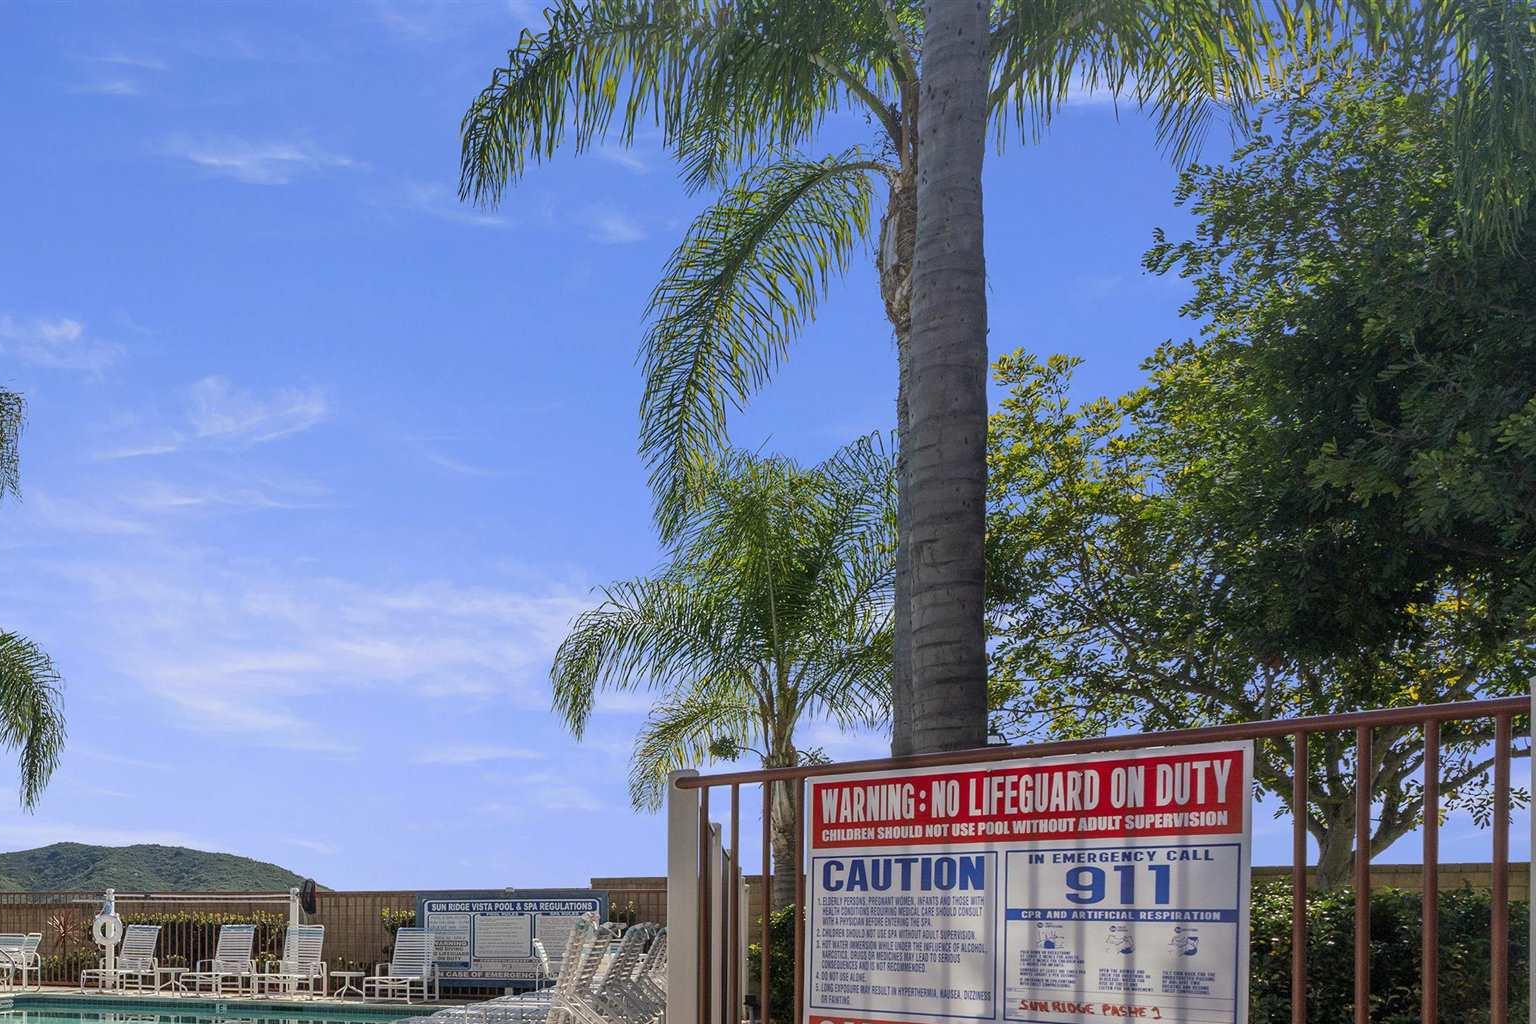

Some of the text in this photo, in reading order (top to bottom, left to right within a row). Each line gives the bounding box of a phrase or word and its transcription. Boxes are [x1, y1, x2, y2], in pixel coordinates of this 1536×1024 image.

[931, 779, 960, 818] NO
[969, 769, 1099, 817] LIFEGUARD
[1111, 766, 1148, 808] ON
[1156, 759, 1232, 807] DUTY
[822, 811, 1228, 842] CHILDREN SHOULD NOT USE POOL WITHOUT ADULT SUPERVISION
[1029, 848, 1215, 864] IN EMERGENCY CALL
[822, 855, 985, 892] CAUTION
[1065, 865, 1171, 905] 911
[431, 903, 592, 911] SUN RIDGE VISTA POOL & SPA REGULATIONS
[1021, 911, 1221, 921] CPR AND ARTIFICIAL RESPIRATION
